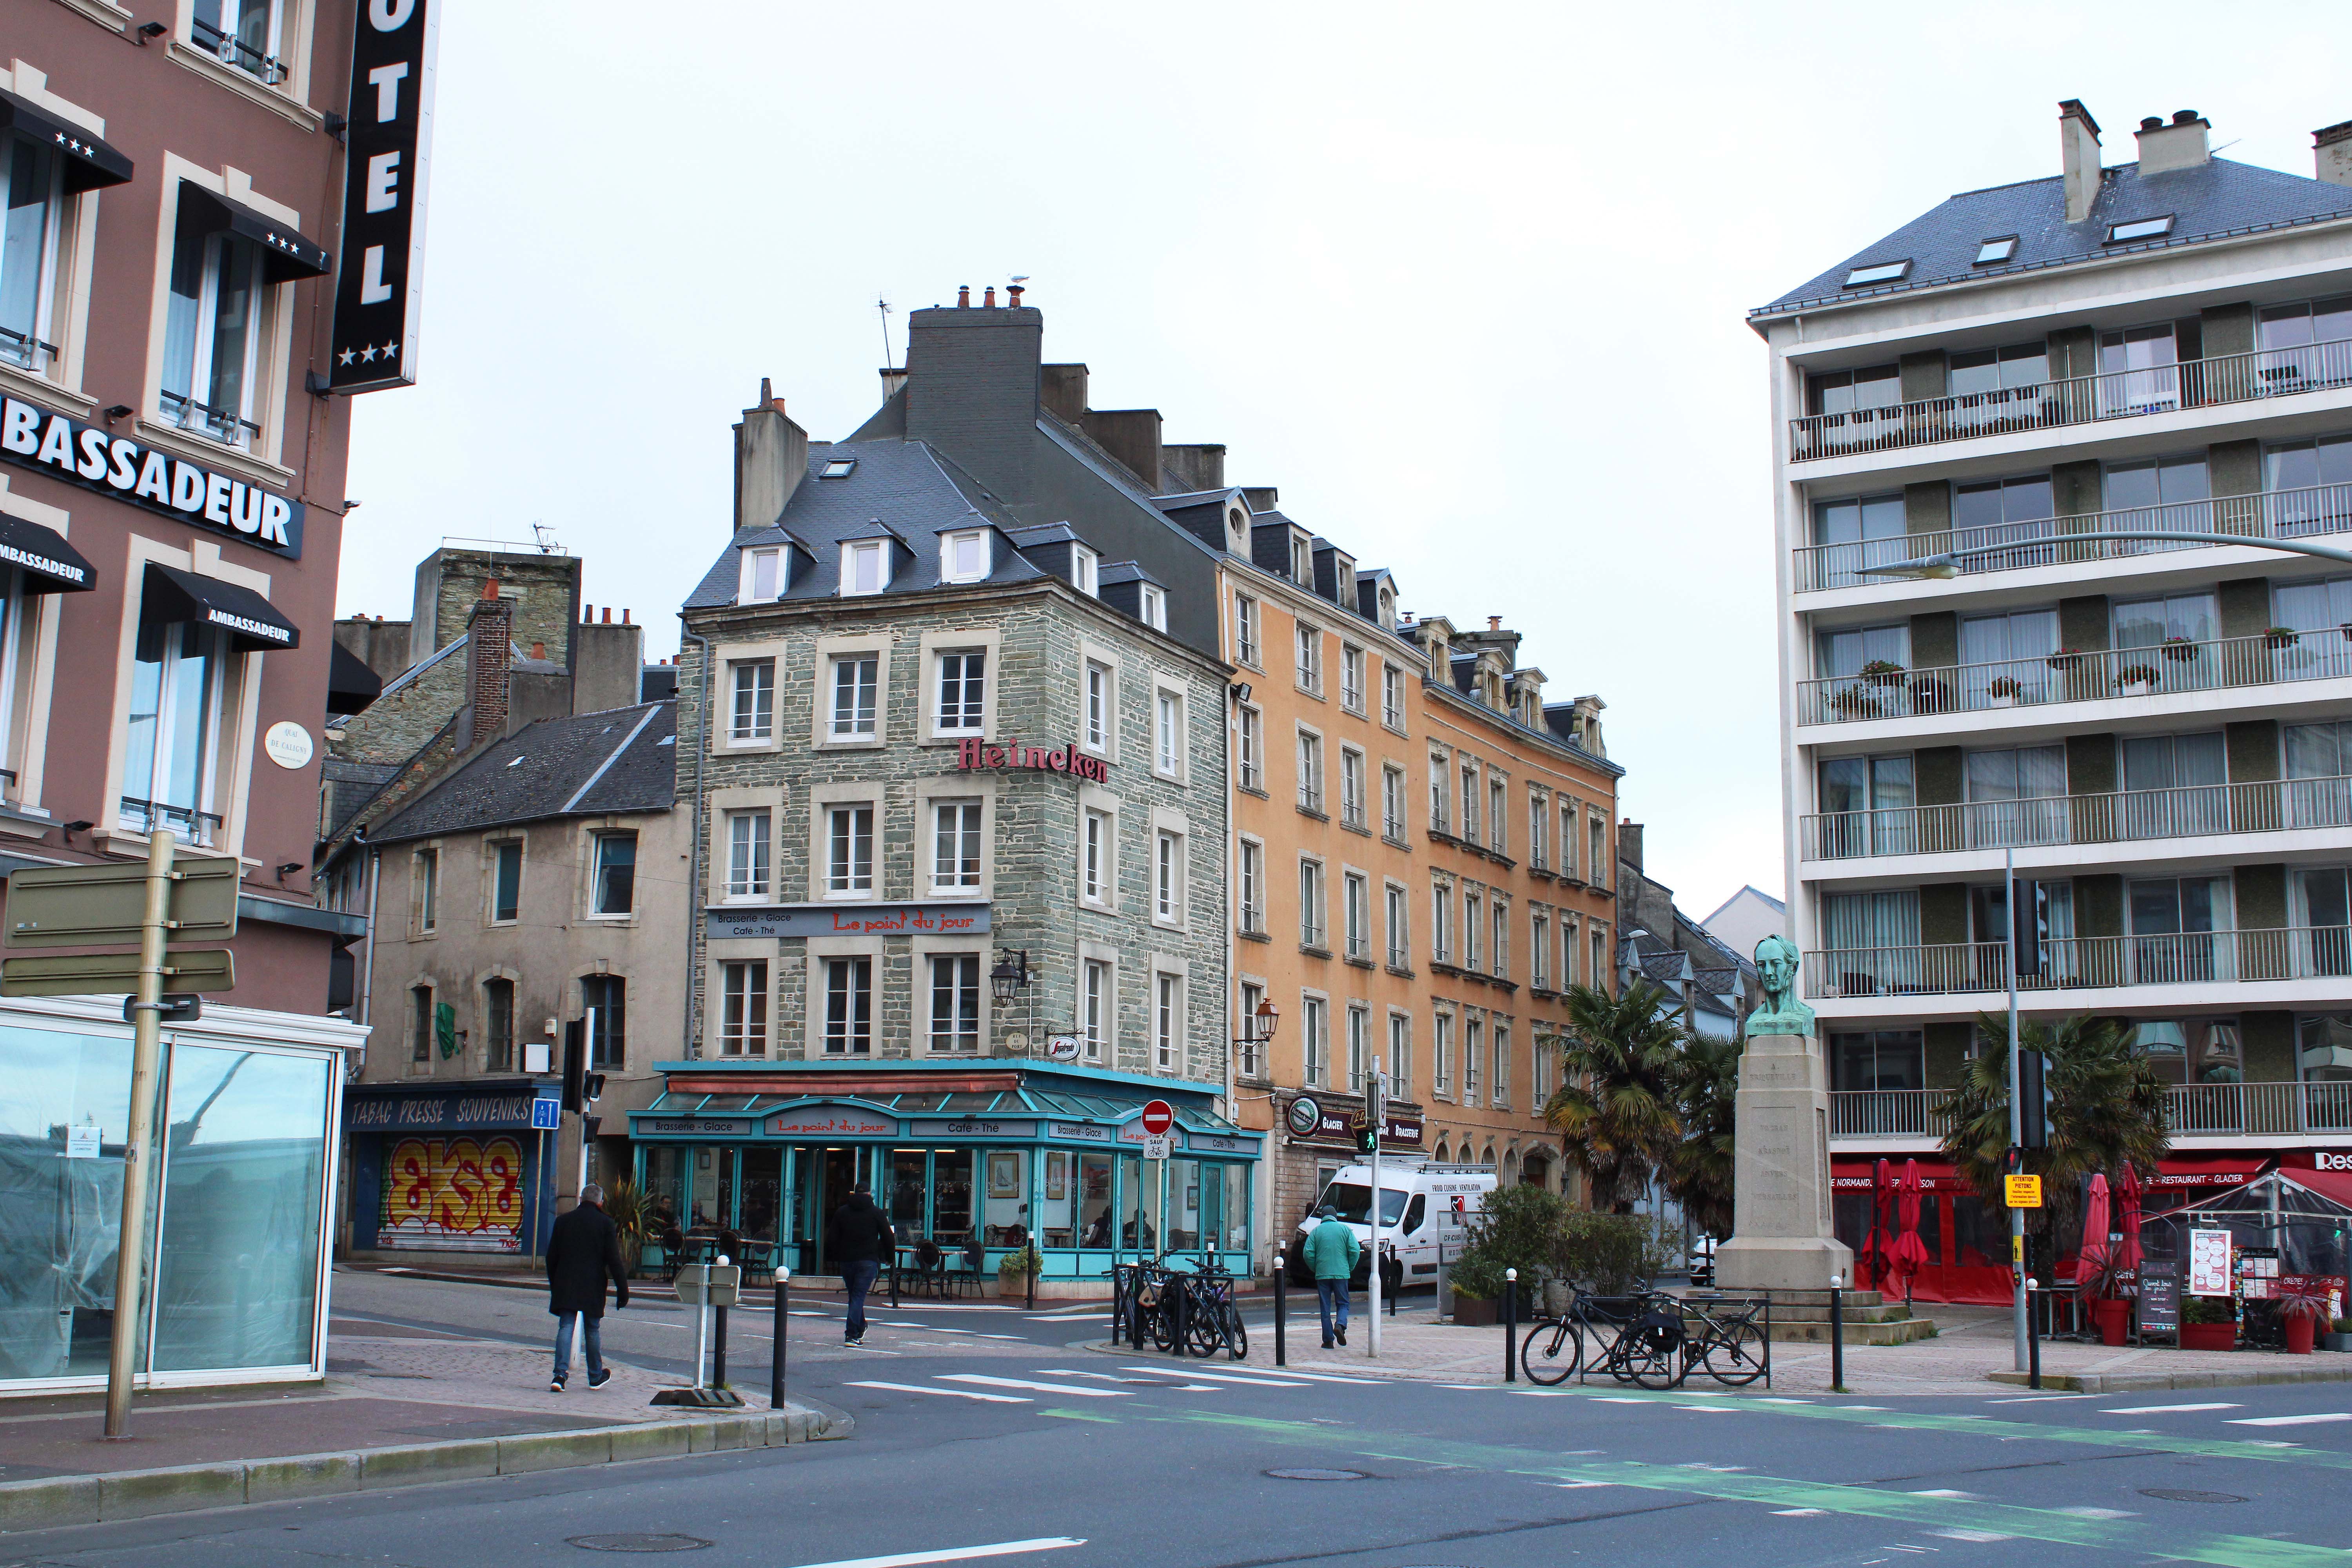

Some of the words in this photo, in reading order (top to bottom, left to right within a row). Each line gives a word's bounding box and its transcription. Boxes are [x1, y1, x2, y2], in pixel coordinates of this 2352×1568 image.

[0, 396, 292, 547] BASSADEUR
[209, 608, 290, 642] AMBASSADEUR
[285, 728, 298, 737] QUAI
[281, 742, 307, 755] CALIGNY
[957, 737, 1108, 783] Heineken
[718, 914, 758, 923] Brasserie
[833, 912, 860, 930] Le
[864, 909, 907, 933] point
[912, 909, 934, 928] du
[938, 913, 974, 931] jour
[733, 926, 753, 935] Café
[761, 926, 775, 934] Thé
[1052, 1041, 1074, 1054] Segafredo
[352, 1100, 392, 1124] TABAC
[399, 1099, 447, 1123] PRESSE
[456, 1096, 530, 1122] SOUVENIRS
[1292, 1107, 1312, 1124] Heineken
[656, 1122, 695, 1131] Brasserie
[704, 1122, 733, 1131] Glace
[778, 1119, 799, 1131] Le
[802, 1119, 835, 1132] point
[839, 1119, 855, 1131] du
[858, 1122, 886, 1133] jour
[948, 1123, 972, 1132] Café
[982, 1123, 999, 1132] Thé
[1322, 1116, 1343, 1131] GLACIER
[1058, 1125, 1081, 1135] Brasserie
[1085, 1127, 1102, 1137] Glace
[1123, 1127, 1134, 1139] Le
[1395, 1124, 1419, 1138] BRASSERIE
[1213, 1138, 1223, 1148] Café
[1919, 1180, 1935, 1188] SON
[2161, 1175, 2206, 1184] RESTAURANT
[2214, 1173, 2243, 1183] GLACIER
